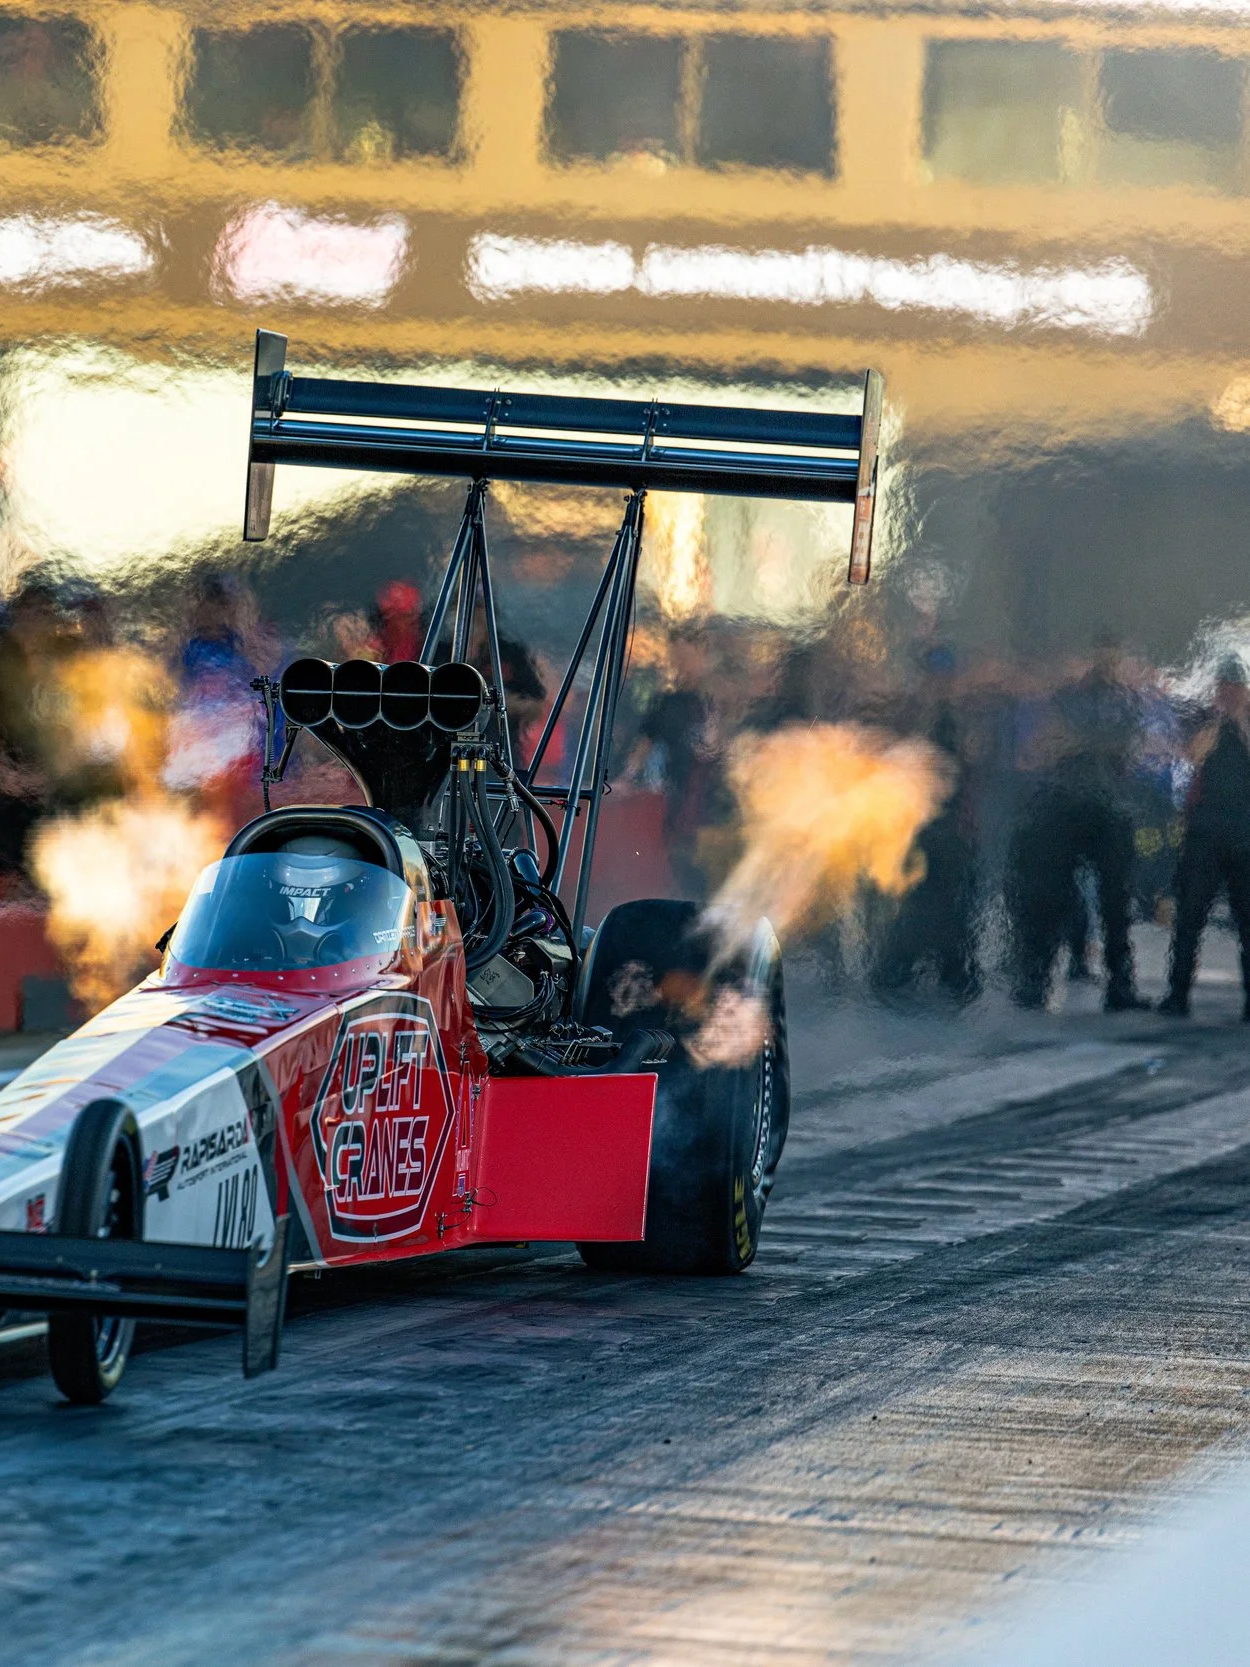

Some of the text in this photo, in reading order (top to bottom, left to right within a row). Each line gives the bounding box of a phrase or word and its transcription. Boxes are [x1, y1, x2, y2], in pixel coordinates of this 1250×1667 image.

[279, 886, 332, 897] IMPACT
[341, 1030, 431, 1115] UPLIFT
[330, 1116, 430, 1203] CRANES
